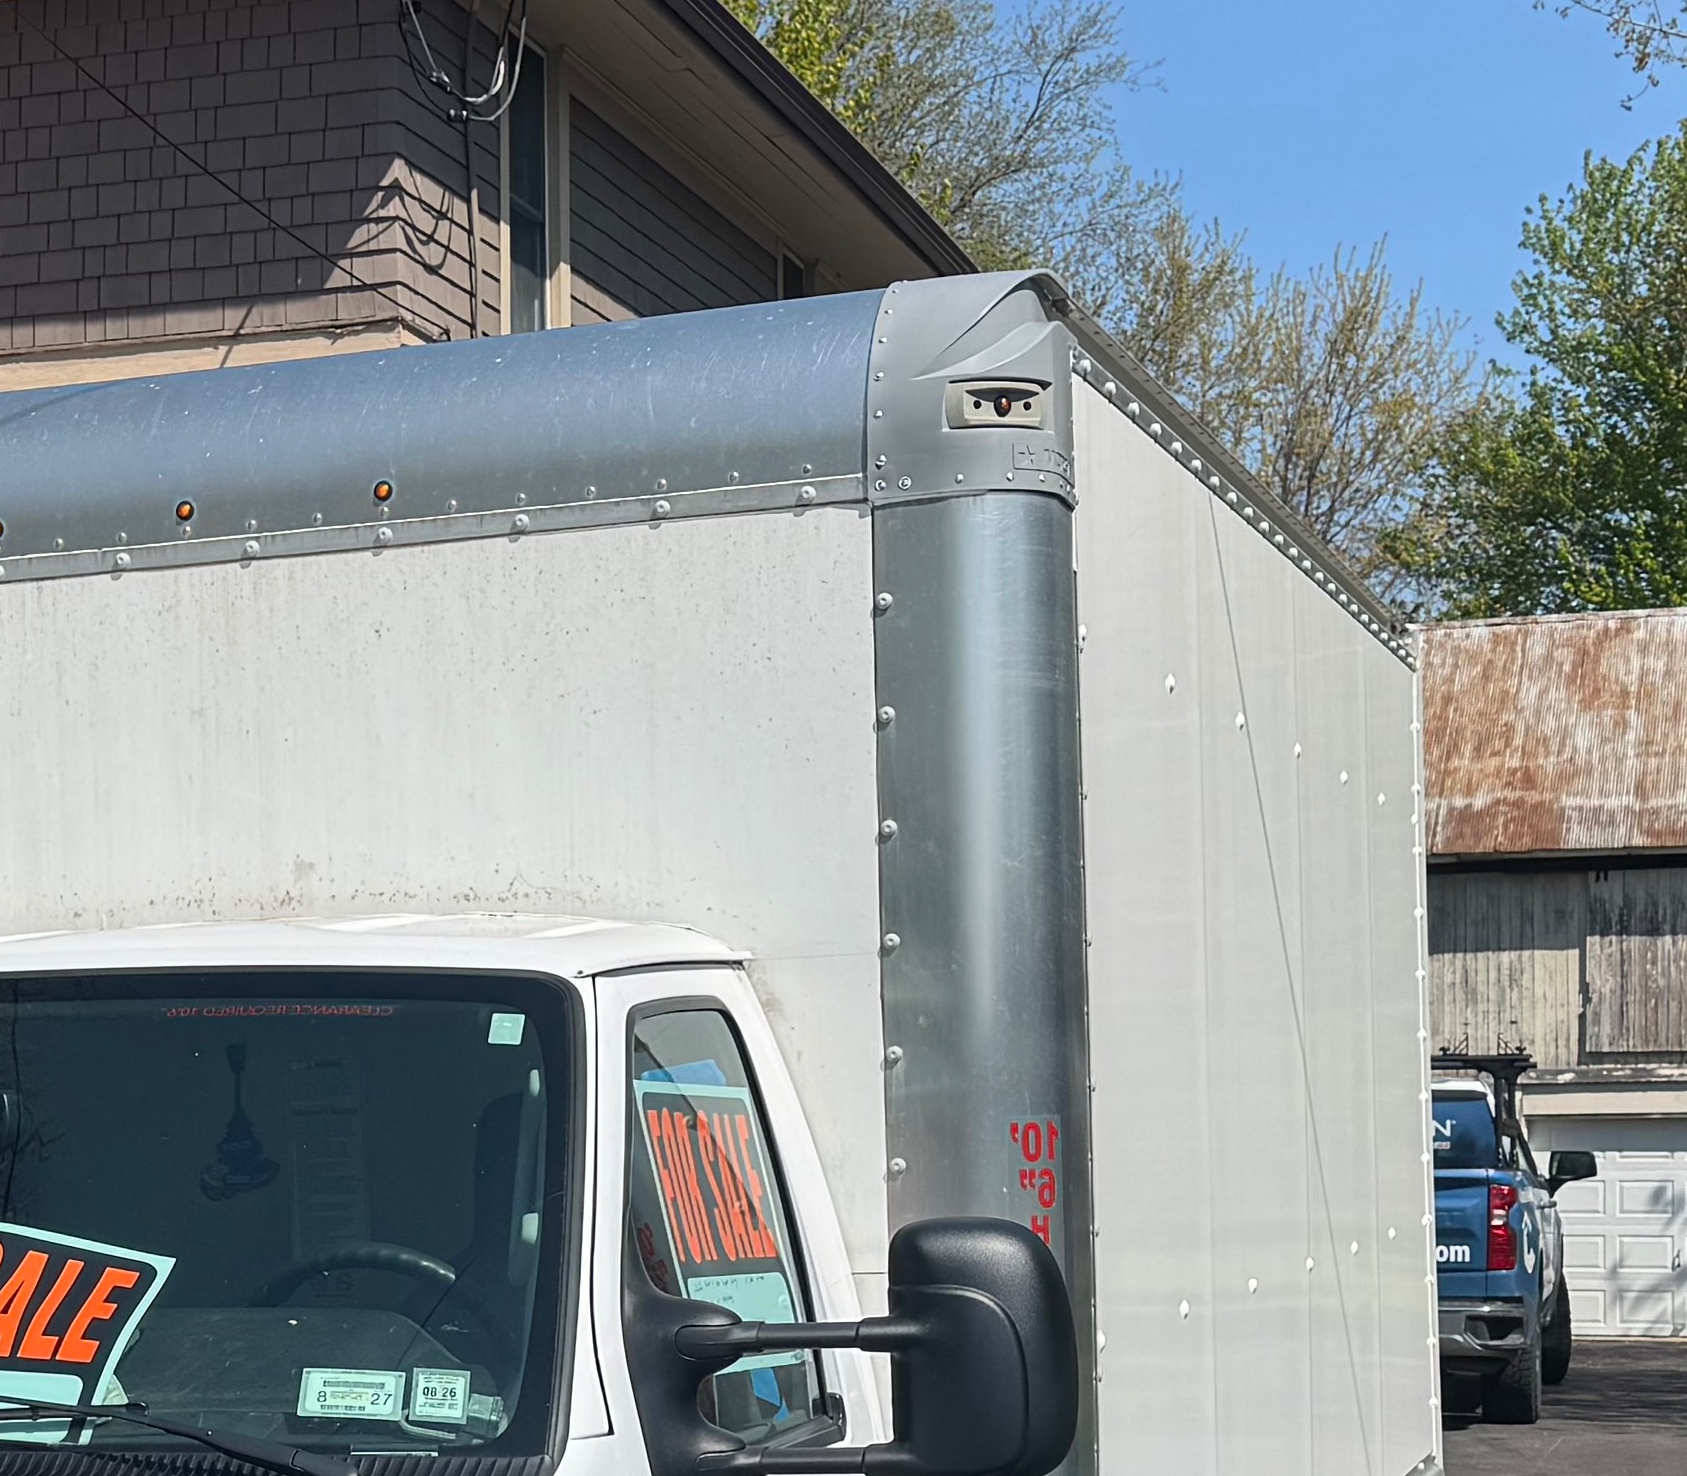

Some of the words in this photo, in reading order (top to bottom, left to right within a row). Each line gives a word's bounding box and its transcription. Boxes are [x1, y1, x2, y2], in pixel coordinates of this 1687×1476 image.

[646, 1107, 719, 1264] FOR
[696, 1108, 780, 1263] SALE
[316, 1390, 327, 1404] 8
[370, 1392, 393, 1406] 27
[441, 1386, 457, 1399] 26
